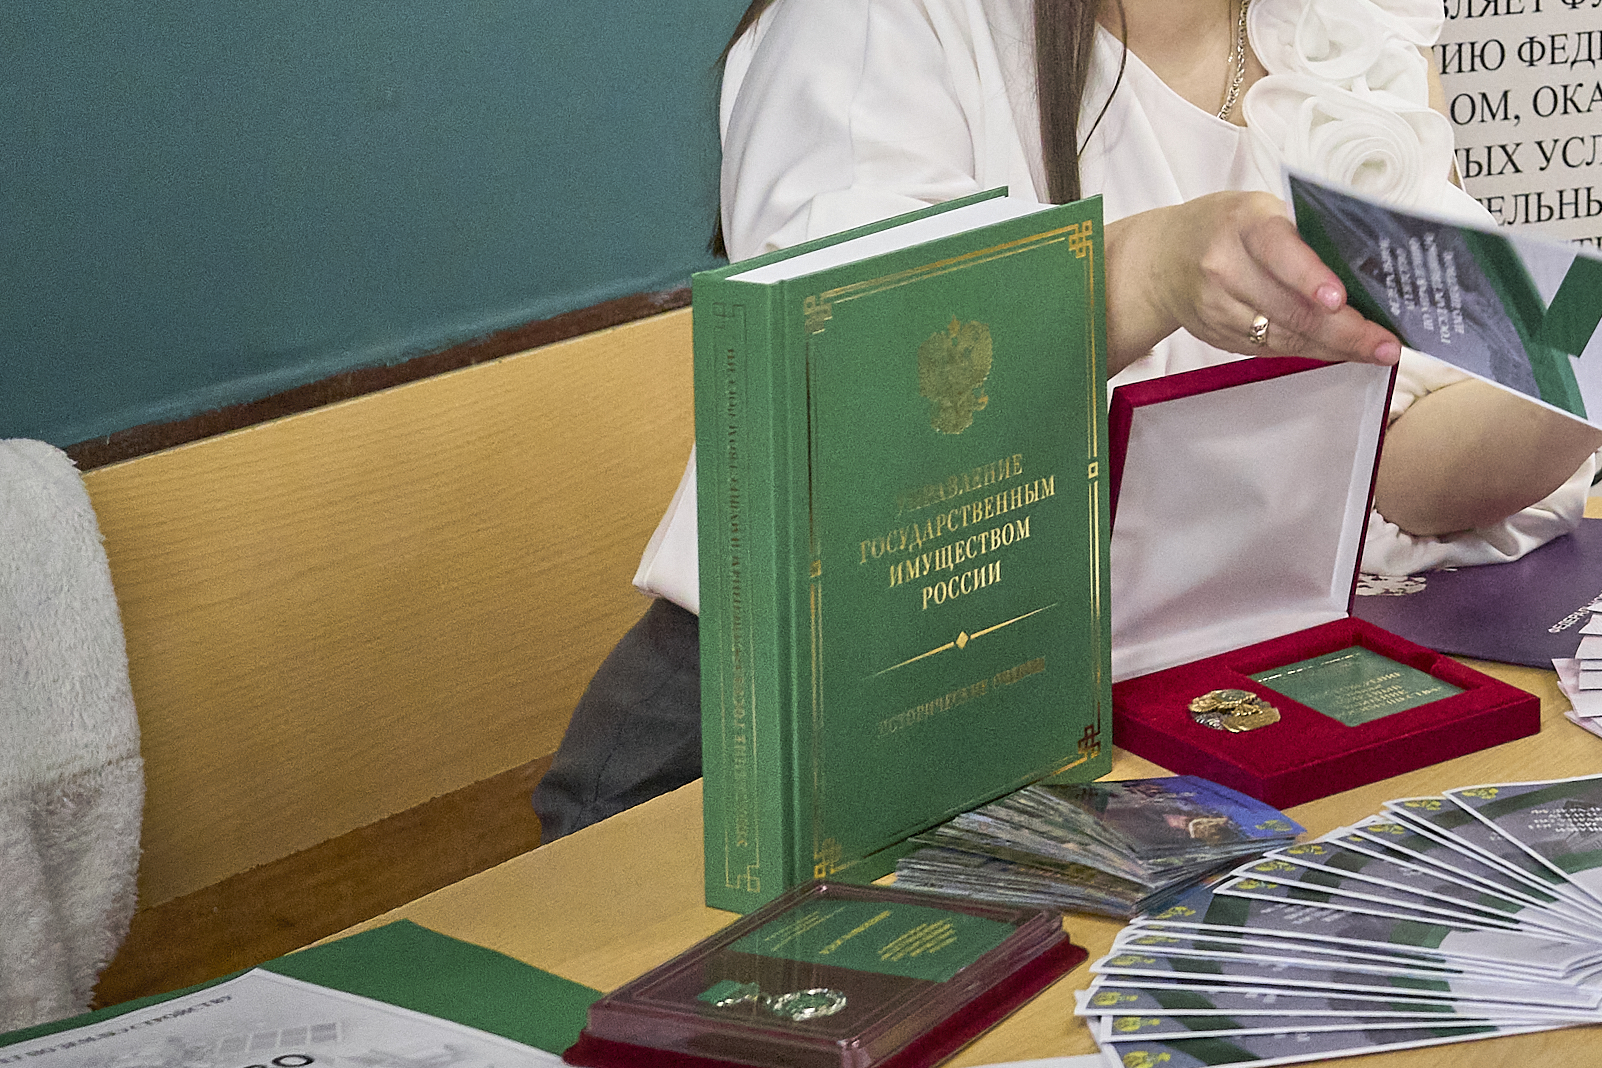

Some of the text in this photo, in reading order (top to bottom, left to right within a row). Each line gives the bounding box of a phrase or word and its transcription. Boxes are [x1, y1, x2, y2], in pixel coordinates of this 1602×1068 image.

[1432, 39, 1505, 75] ИЮ
[1455, 142, 1523, 179] ЫХ
[860, 474, 1056, 565] ГОСУДАРСТВЕННЫМ
[889, 516, 1031, 588] ИМУЩЕСТВОМ
[922, 560, 1002, 610] РОССИИ
